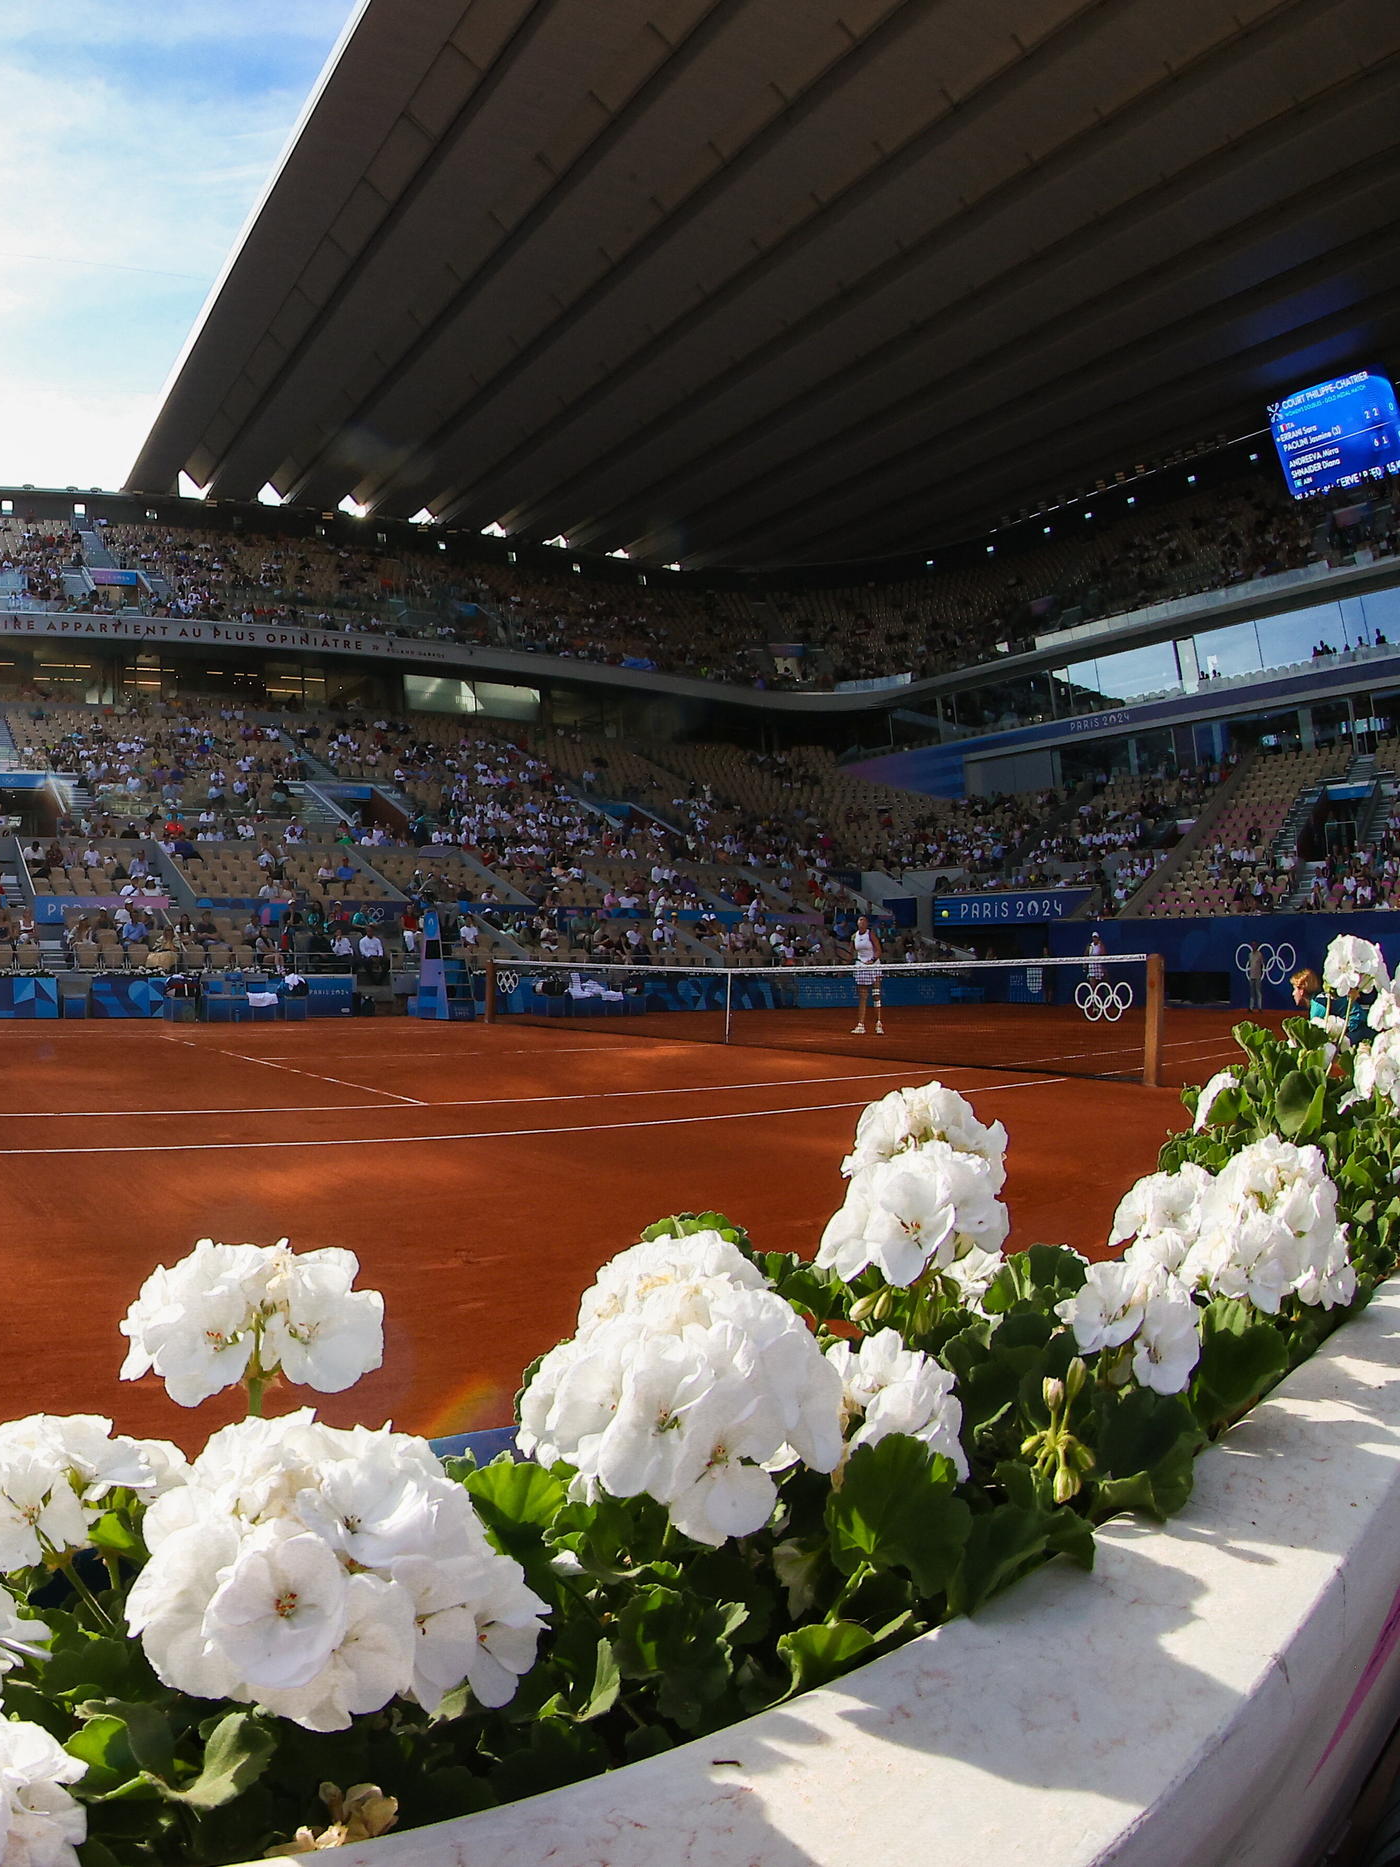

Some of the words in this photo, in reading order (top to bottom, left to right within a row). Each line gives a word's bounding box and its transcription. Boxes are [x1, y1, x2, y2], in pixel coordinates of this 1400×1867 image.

[1282, 394, 1305, 409] COURT
[1306, 371, 1368, 401] PHILIPPE-CHATRIER
[1364, 410, 1371, 419] 2
[1372, 408, 1379, 416] 2
[1388, 402, 1394, 410] 0
[1280, 428, 1303, 442] ERRANI
[1302, 425, 1318, 434] Sara
[1374, 438, 1380, 447] 6
[1382, 436, 1388, 444] 1
[1283, 438, 1308, 452] PAOLINI
[1289, 452, 1322, 468] ANDREEVA
[1322, 448, 1340, 458] Mirra
[1291, 462, 1322, 478] SHNAIDER
[1322, 458, 1341, 469] Diana
[46, 621, 169, 636] APPARTIENT
[179, 627, 201, 638] AU
[213, 629, 256, 642] PLUS
[266, 633, 363, 650] OPINIÂTRE
[1102, 712, 1130, 726] 2024
[1016, 900, 1062, 917] 2024
